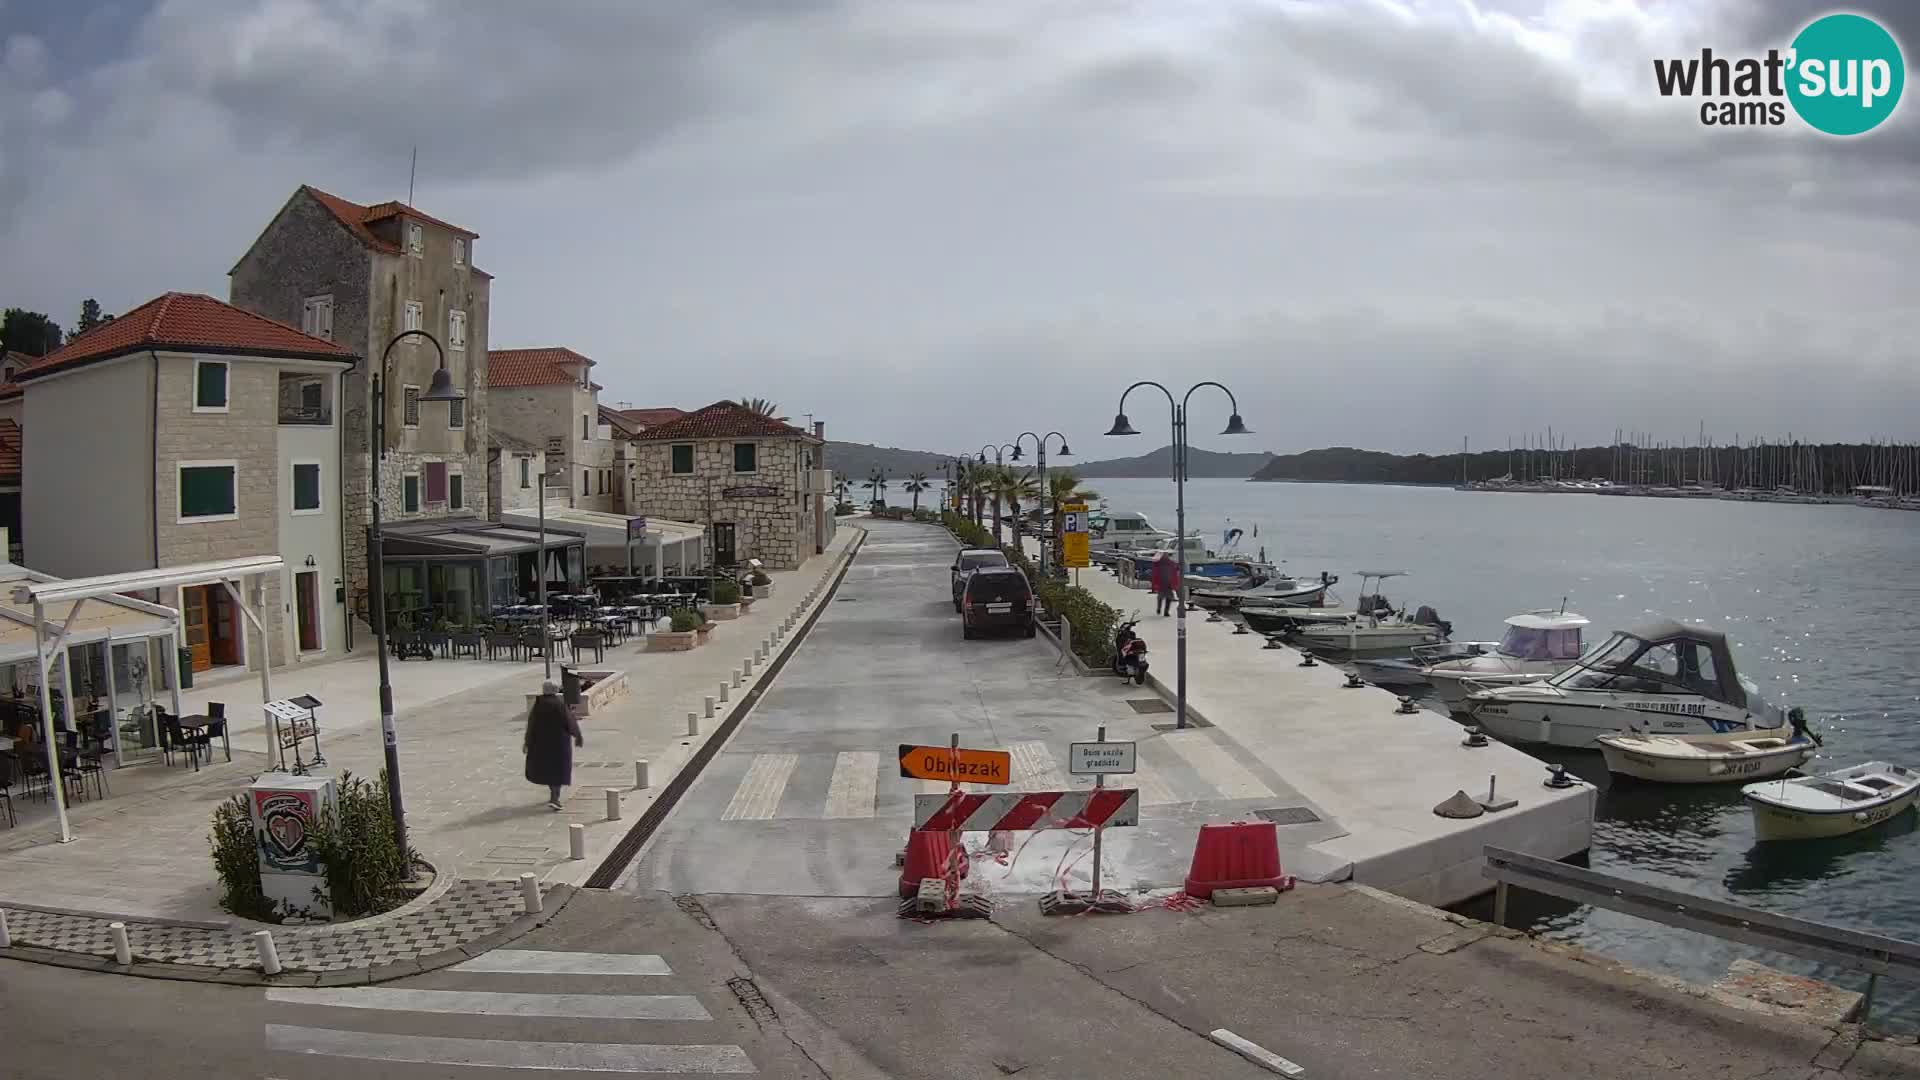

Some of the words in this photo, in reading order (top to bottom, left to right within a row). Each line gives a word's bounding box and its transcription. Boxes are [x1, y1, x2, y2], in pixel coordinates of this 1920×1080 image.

[1660, 703, 1679, 713] RENT
[1680, 703, 1686, 712] A
[1687, 703, 1706, 715] BOAT
